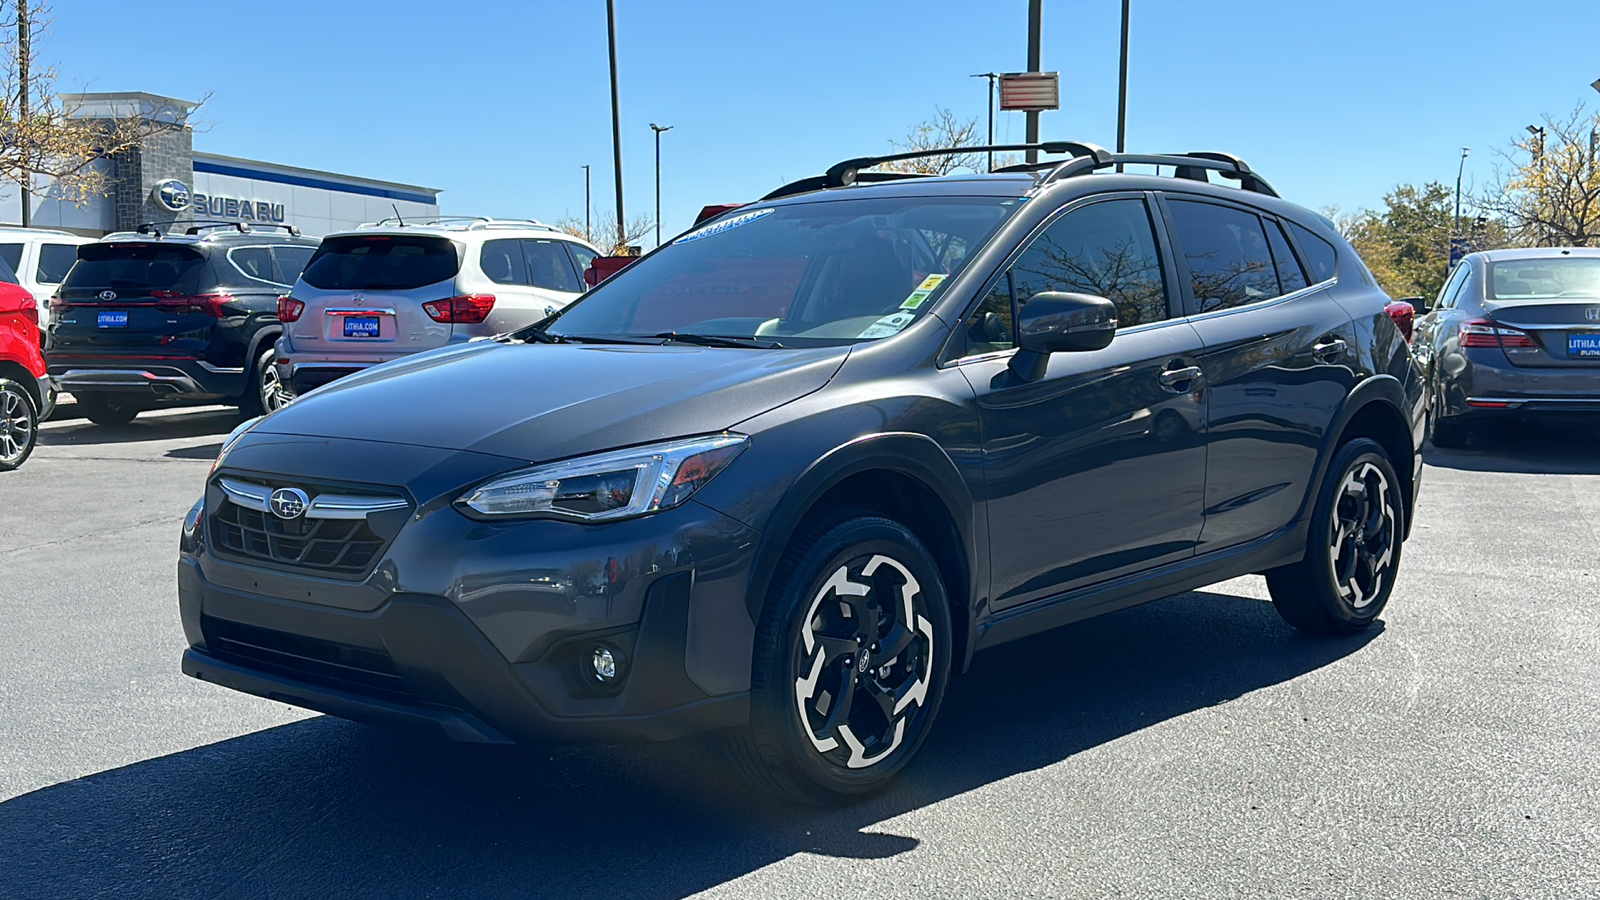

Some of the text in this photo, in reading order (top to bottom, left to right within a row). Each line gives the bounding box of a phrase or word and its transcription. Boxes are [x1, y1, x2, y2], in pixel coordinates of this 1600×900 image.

[193, 193, 284, 223] SUBARU
[98, 315, 128, 323] LITHIA.COM
[345, 323, 377, 331] LITHIA.COM
